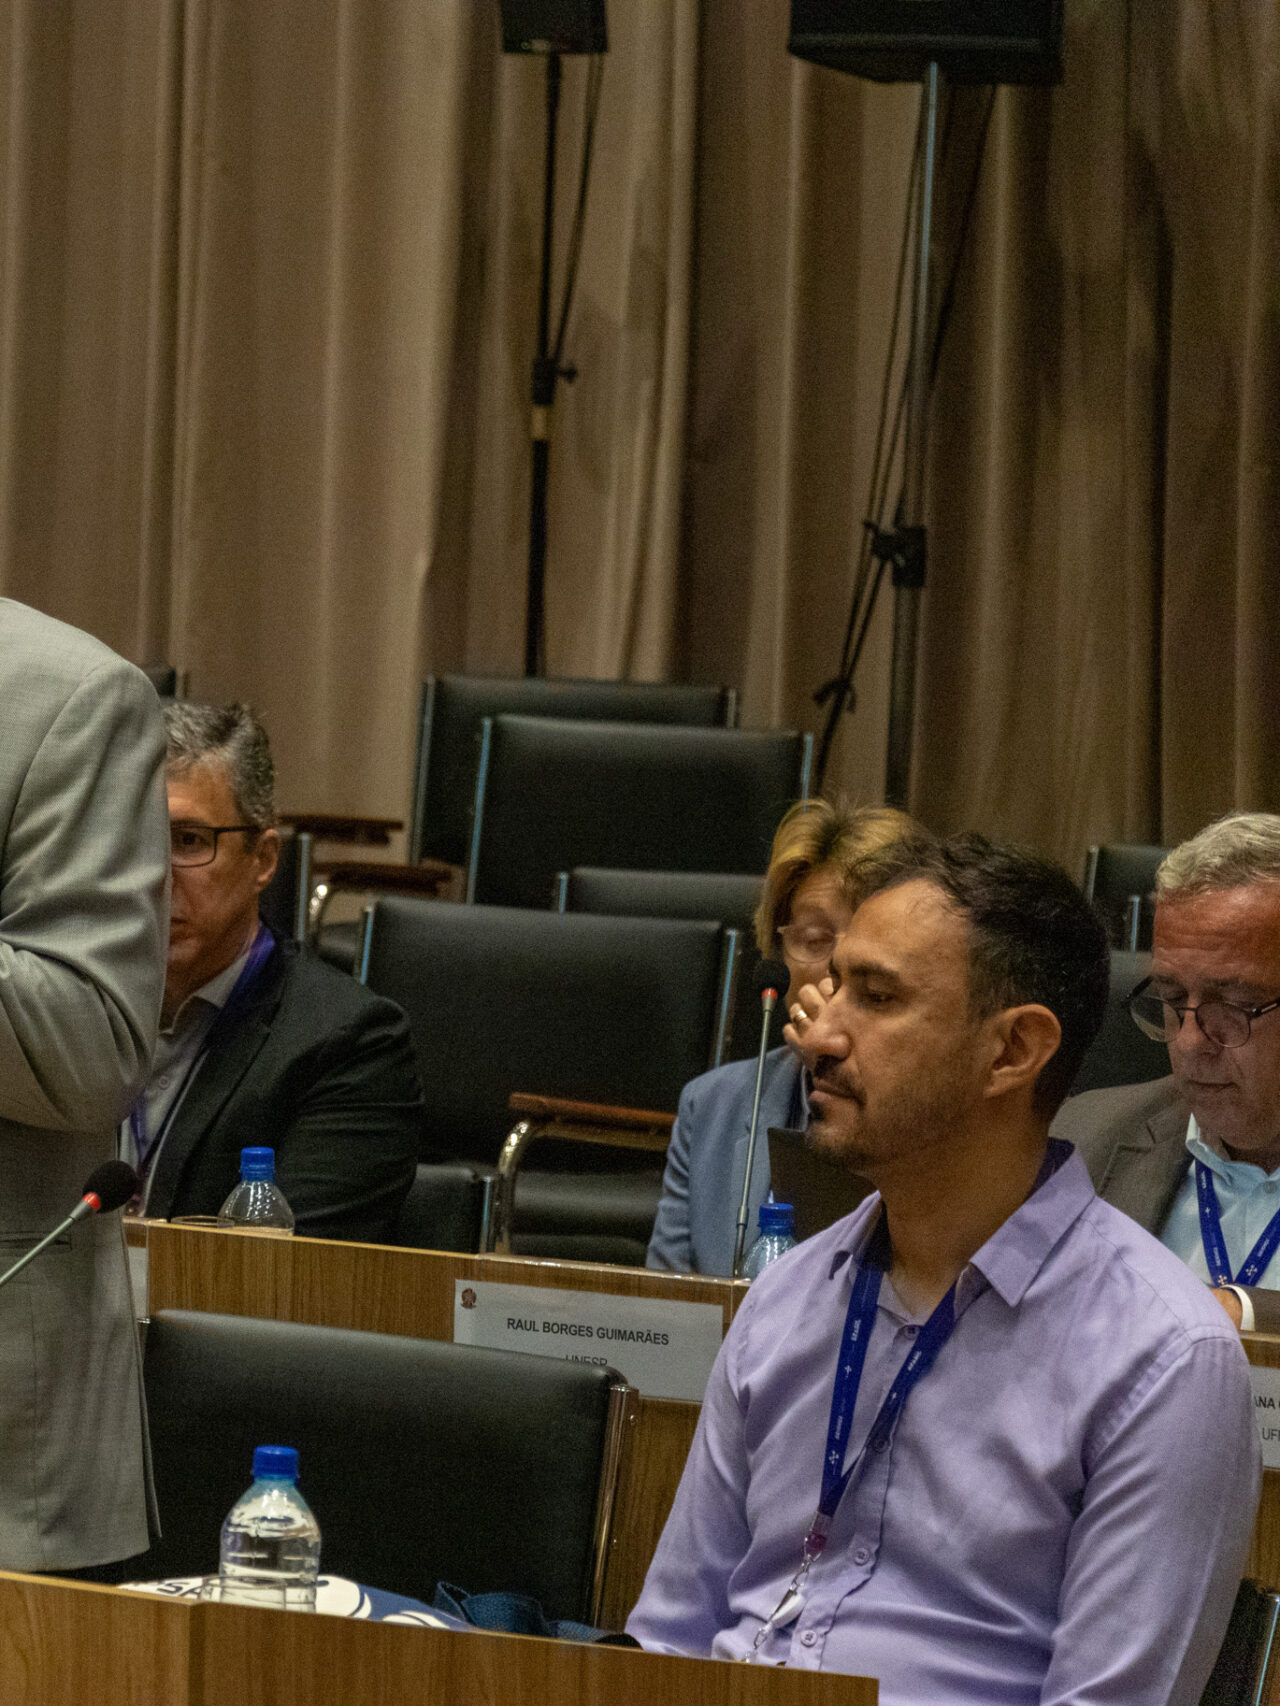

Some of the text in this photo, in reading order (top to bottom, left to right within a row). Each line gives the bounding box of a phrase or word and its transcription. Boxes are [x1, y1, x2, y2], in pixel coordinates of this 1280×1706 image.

[507, 1318, 669, 1346] RAUL BORGES GUIMARÃES
[1262, 1427, 1280, 1441] UF
